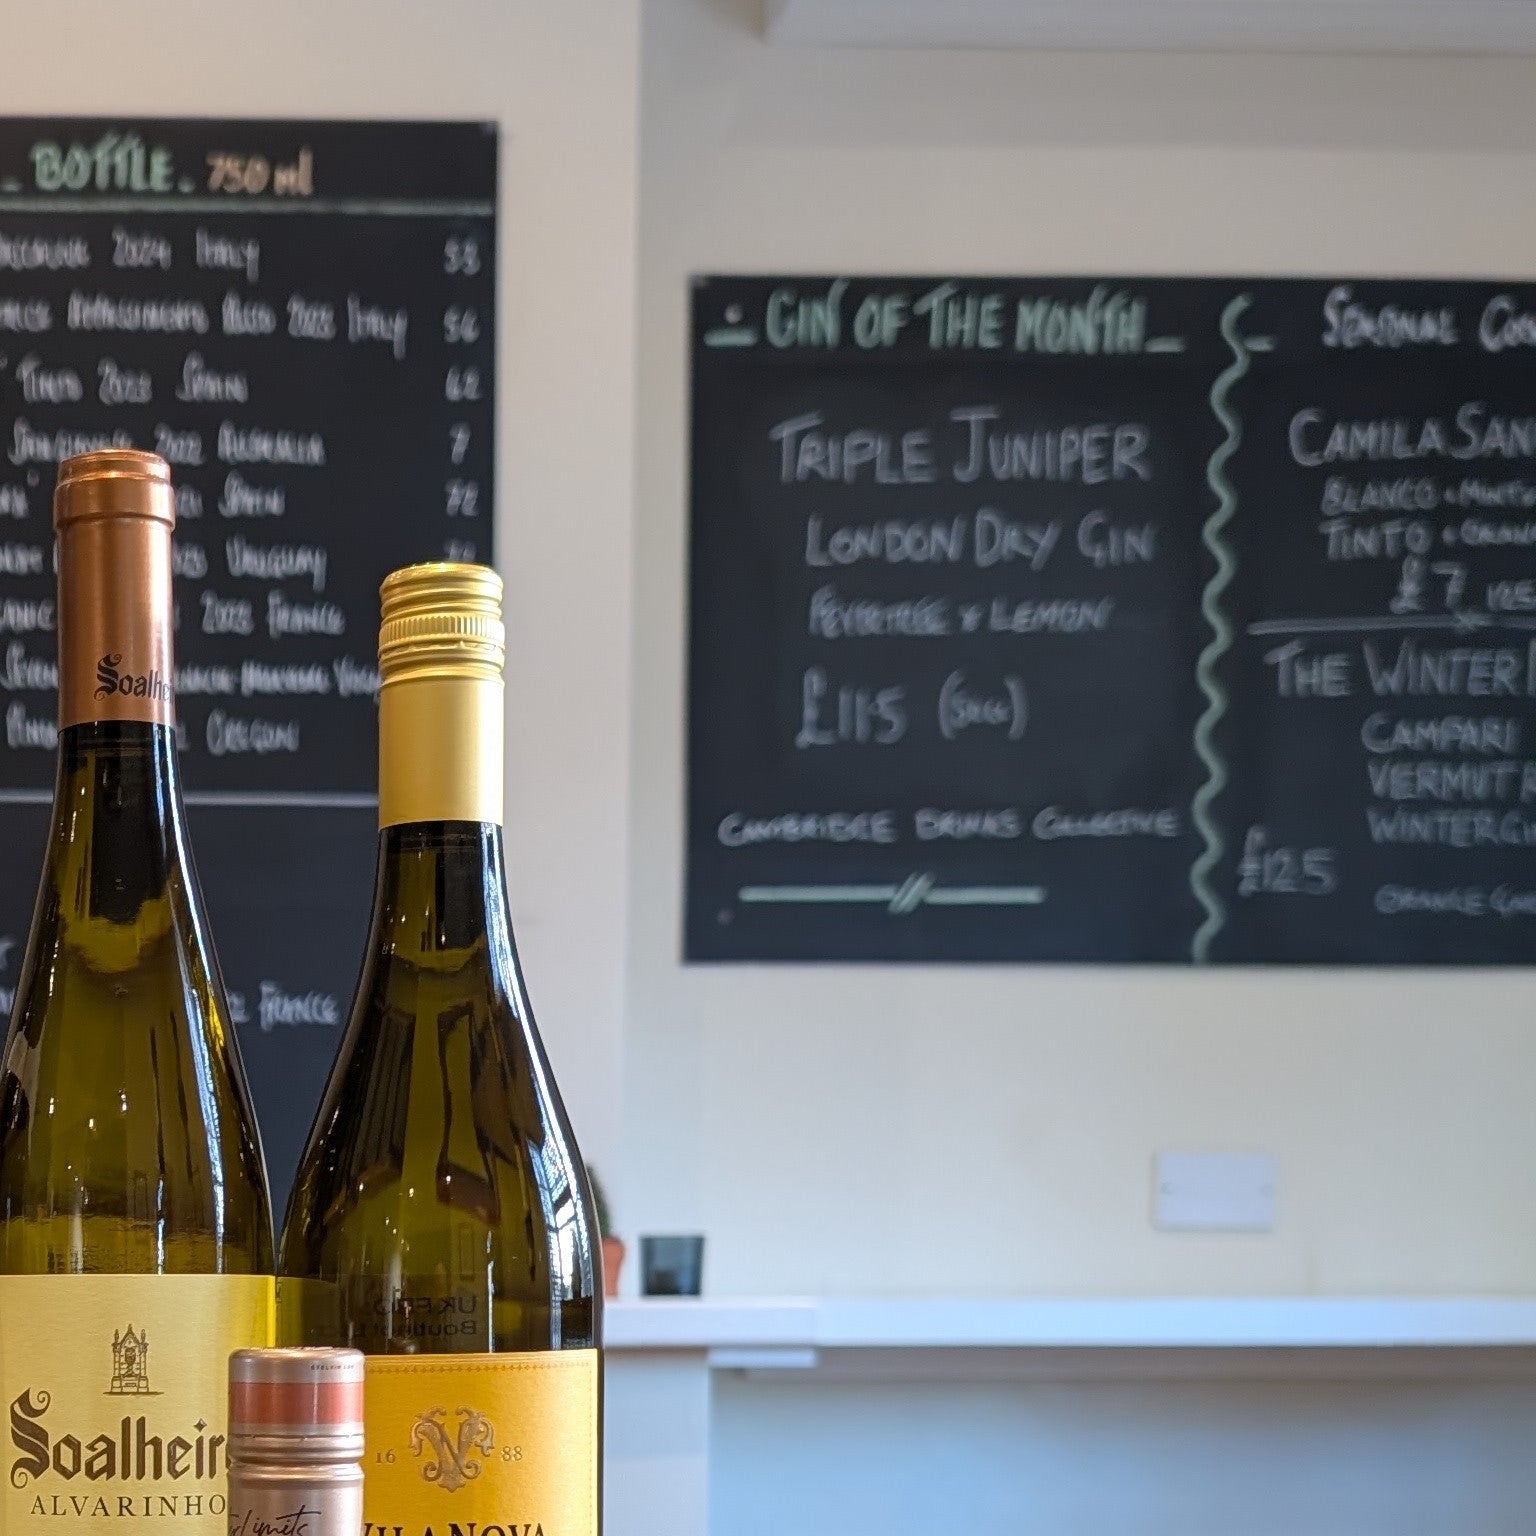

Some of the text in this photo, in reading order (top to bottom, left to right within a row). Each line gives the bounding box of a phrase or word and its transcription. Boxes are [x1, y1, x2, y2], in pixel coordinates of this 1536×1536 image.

[766, 278, 1146, 354] GIN OF THE MONTH
[770, 405, 1152, 484] TRIPLE JUNIPER
[1289, 407, 1446, 467] CAMILA
[804, 505, 1158, 571] LONDON DRY GIN
[1264, 636, 1521, 697] THE WINTER
[1362, 711, 1515, 754] CAMPARI
[10, 1387, 231, 1489] Soalheir
[499, 1445, 523, 1463] 88
[30, 1494, 226, 1517] ALVARINHO
